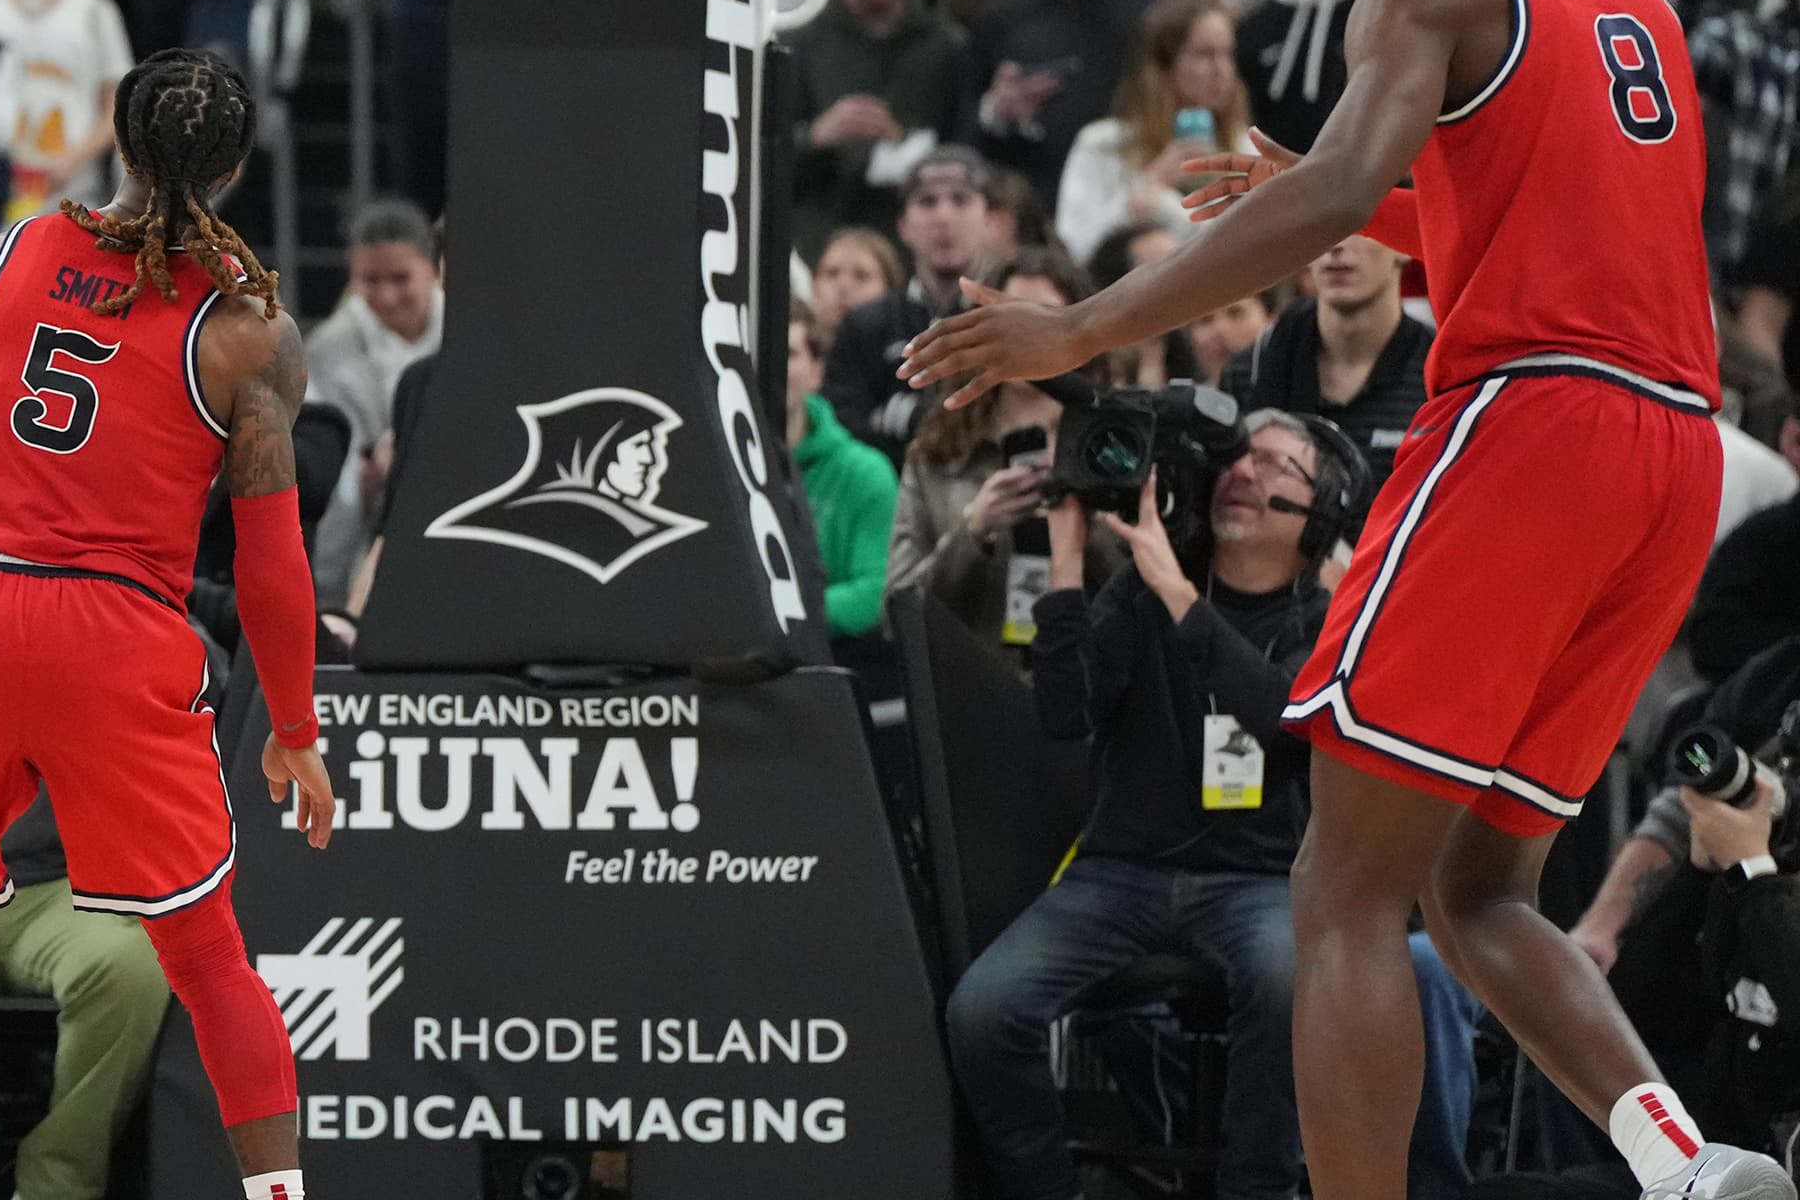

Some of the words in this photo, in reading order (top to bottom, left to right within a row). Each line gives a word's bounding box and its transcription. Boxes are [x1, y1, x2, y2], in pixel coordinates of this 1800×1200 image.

[1594, 13, 1677, 144] 8
[10, 322, 122, 454] 5
[313, 694, 372, 726] EW
[379, 694, 552, 726] ENGLAND
[561, 694, 699, 727] REGION
[564, 848, 635, 884] Feel
[641, 848, 699, 884] the
[705, 849, 819, 884] Power
[413, 1017, 619, 1063] RHODE
[641, 1018, 849, 1064] ISLAND
[297, 1094, 543, 1141] EDICAL
[564, 1096, 847, 1143] IMAGING
